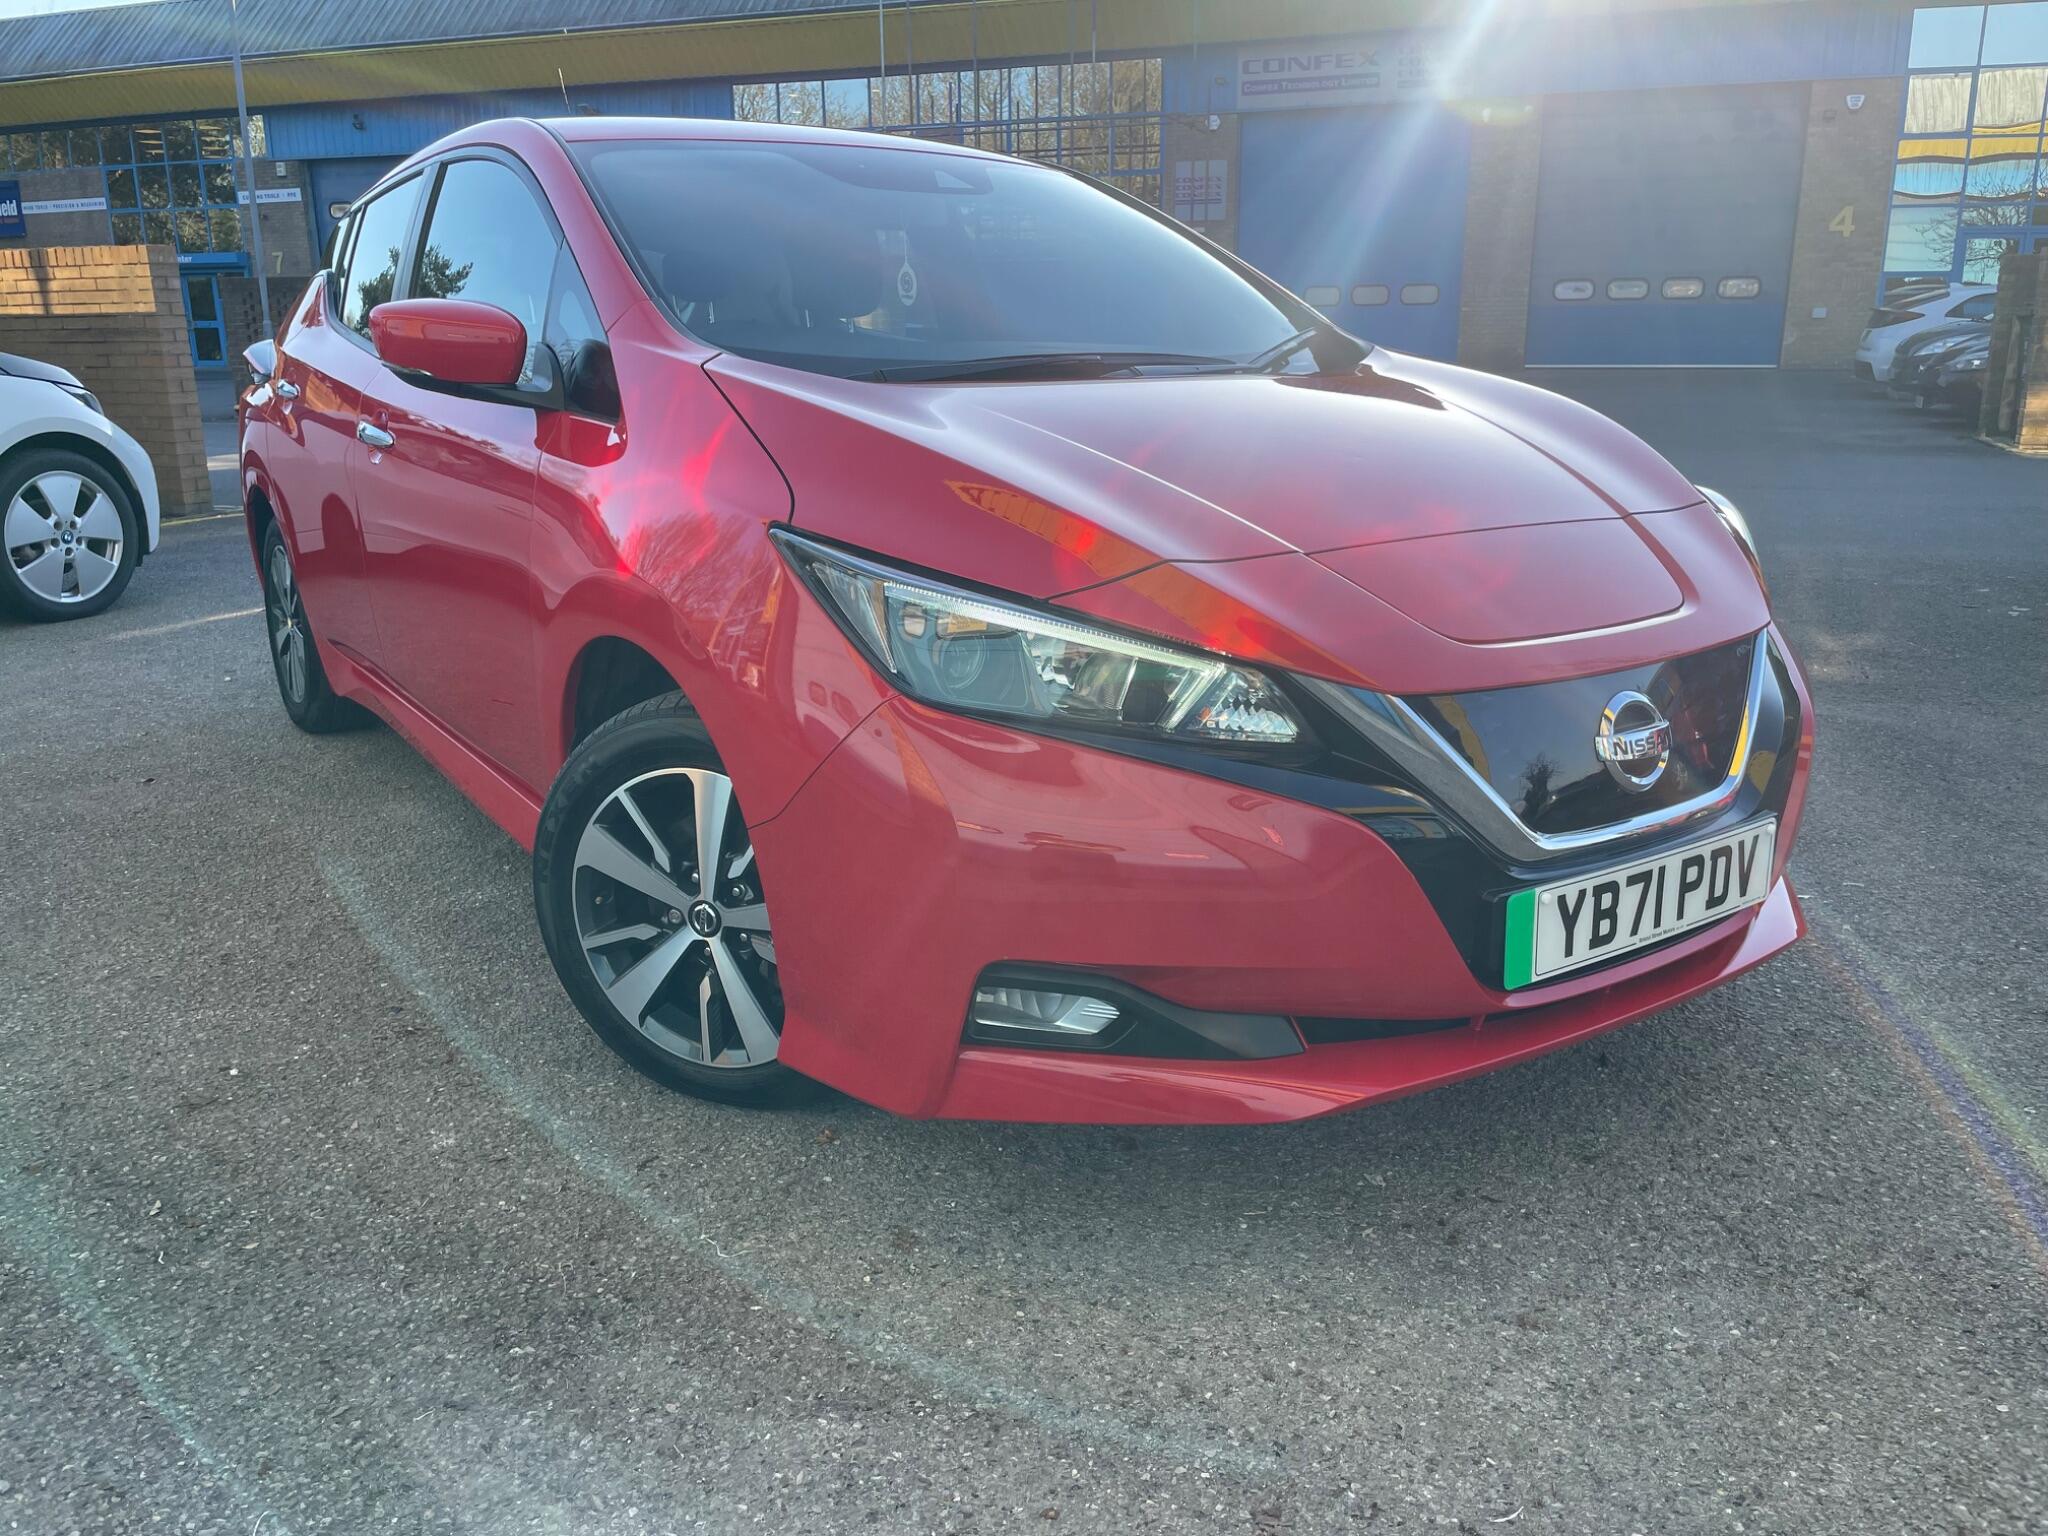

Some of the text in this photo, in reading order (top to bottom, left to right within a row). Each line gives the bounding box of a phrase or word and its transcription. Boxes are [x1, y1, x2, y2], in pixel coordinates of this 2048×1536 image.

[1242, 50, 1379, 75] CONFEX
[1828, 204, 1855, 238] 4
[272, 251, 283, 273] 7
[1557, 834, 1760, 958] YB71 PDV
